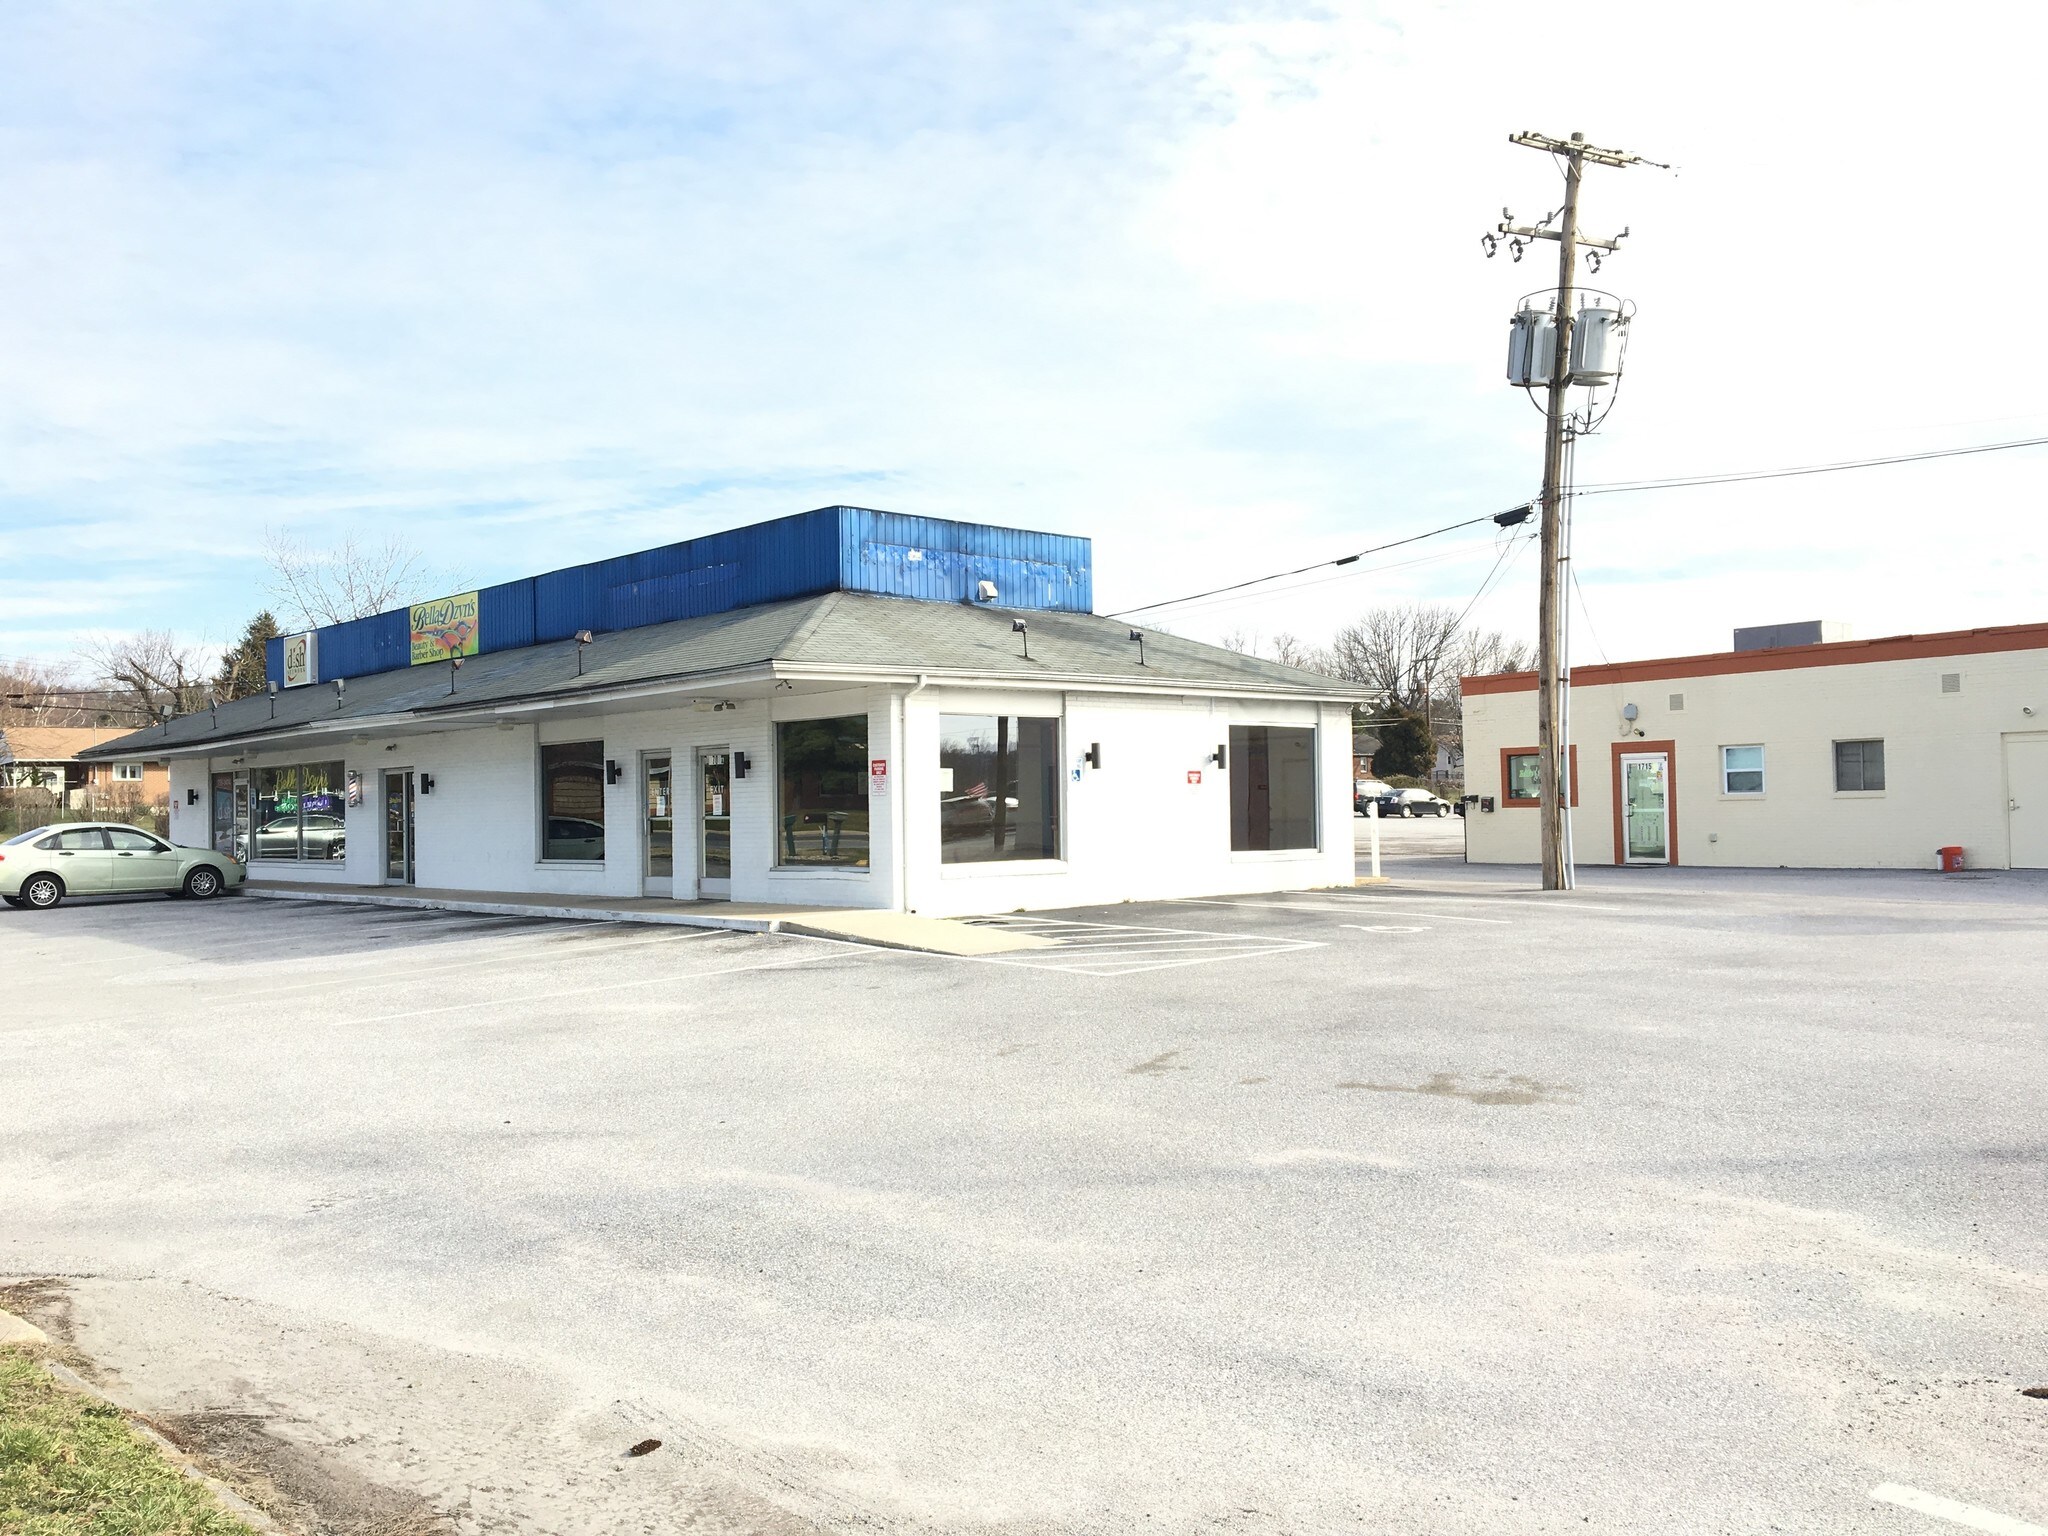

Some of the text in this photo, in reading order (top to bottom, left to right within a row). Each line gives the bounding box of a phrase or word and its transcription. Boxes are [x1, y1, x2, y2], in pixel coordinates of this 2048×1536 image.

[412, 641, 428, 651] Beauty
[412, 648, 444, 660] Barber Shop
[1638, 762, 1652, 770] 1715
[710, 785, 724, 794] EXIT
